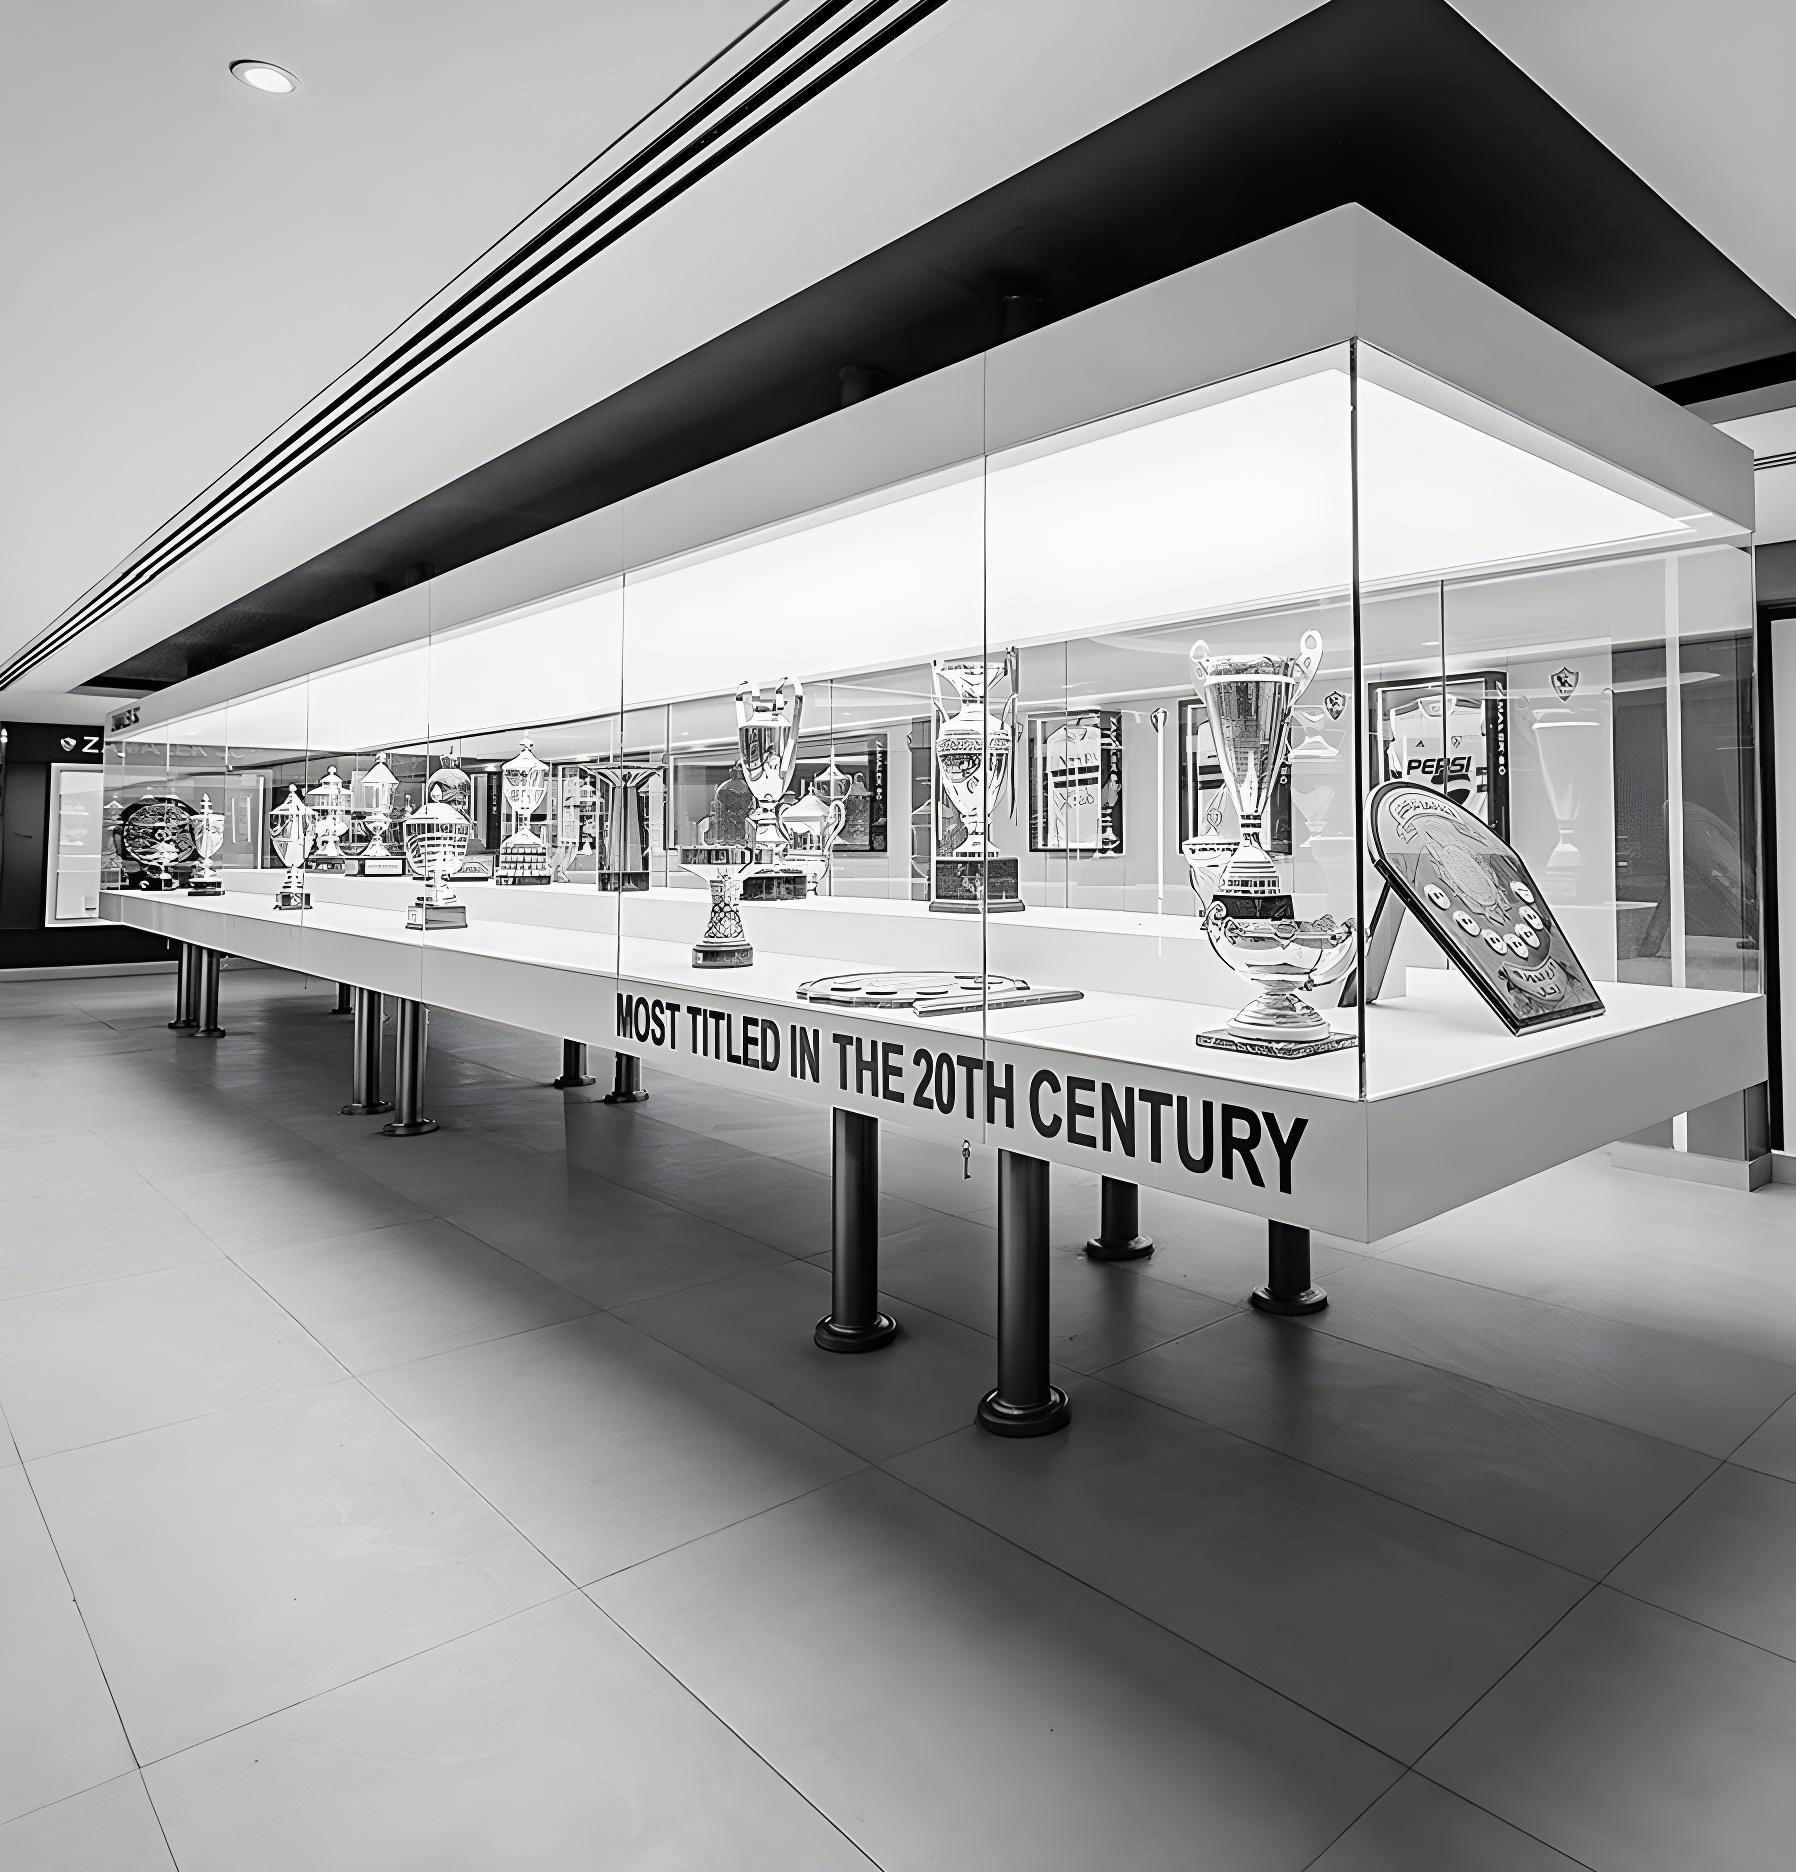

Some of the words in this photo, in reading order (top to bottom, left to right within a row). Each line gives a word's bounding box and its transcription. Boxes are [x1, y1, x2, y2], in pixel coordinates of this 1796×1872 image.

[1407, 756, 1471, 775] PEPSI
[617, 993, 680, 1049] MOST
[687, 1006, 780, 1071] TITLED
[790, 1025, 820, 1083] IN
[832, 1033, 905, 1103] THE
[913, 1049, 1014, 1128] 20TH
[1029, 1069, 1308, 1194] CENTURY
